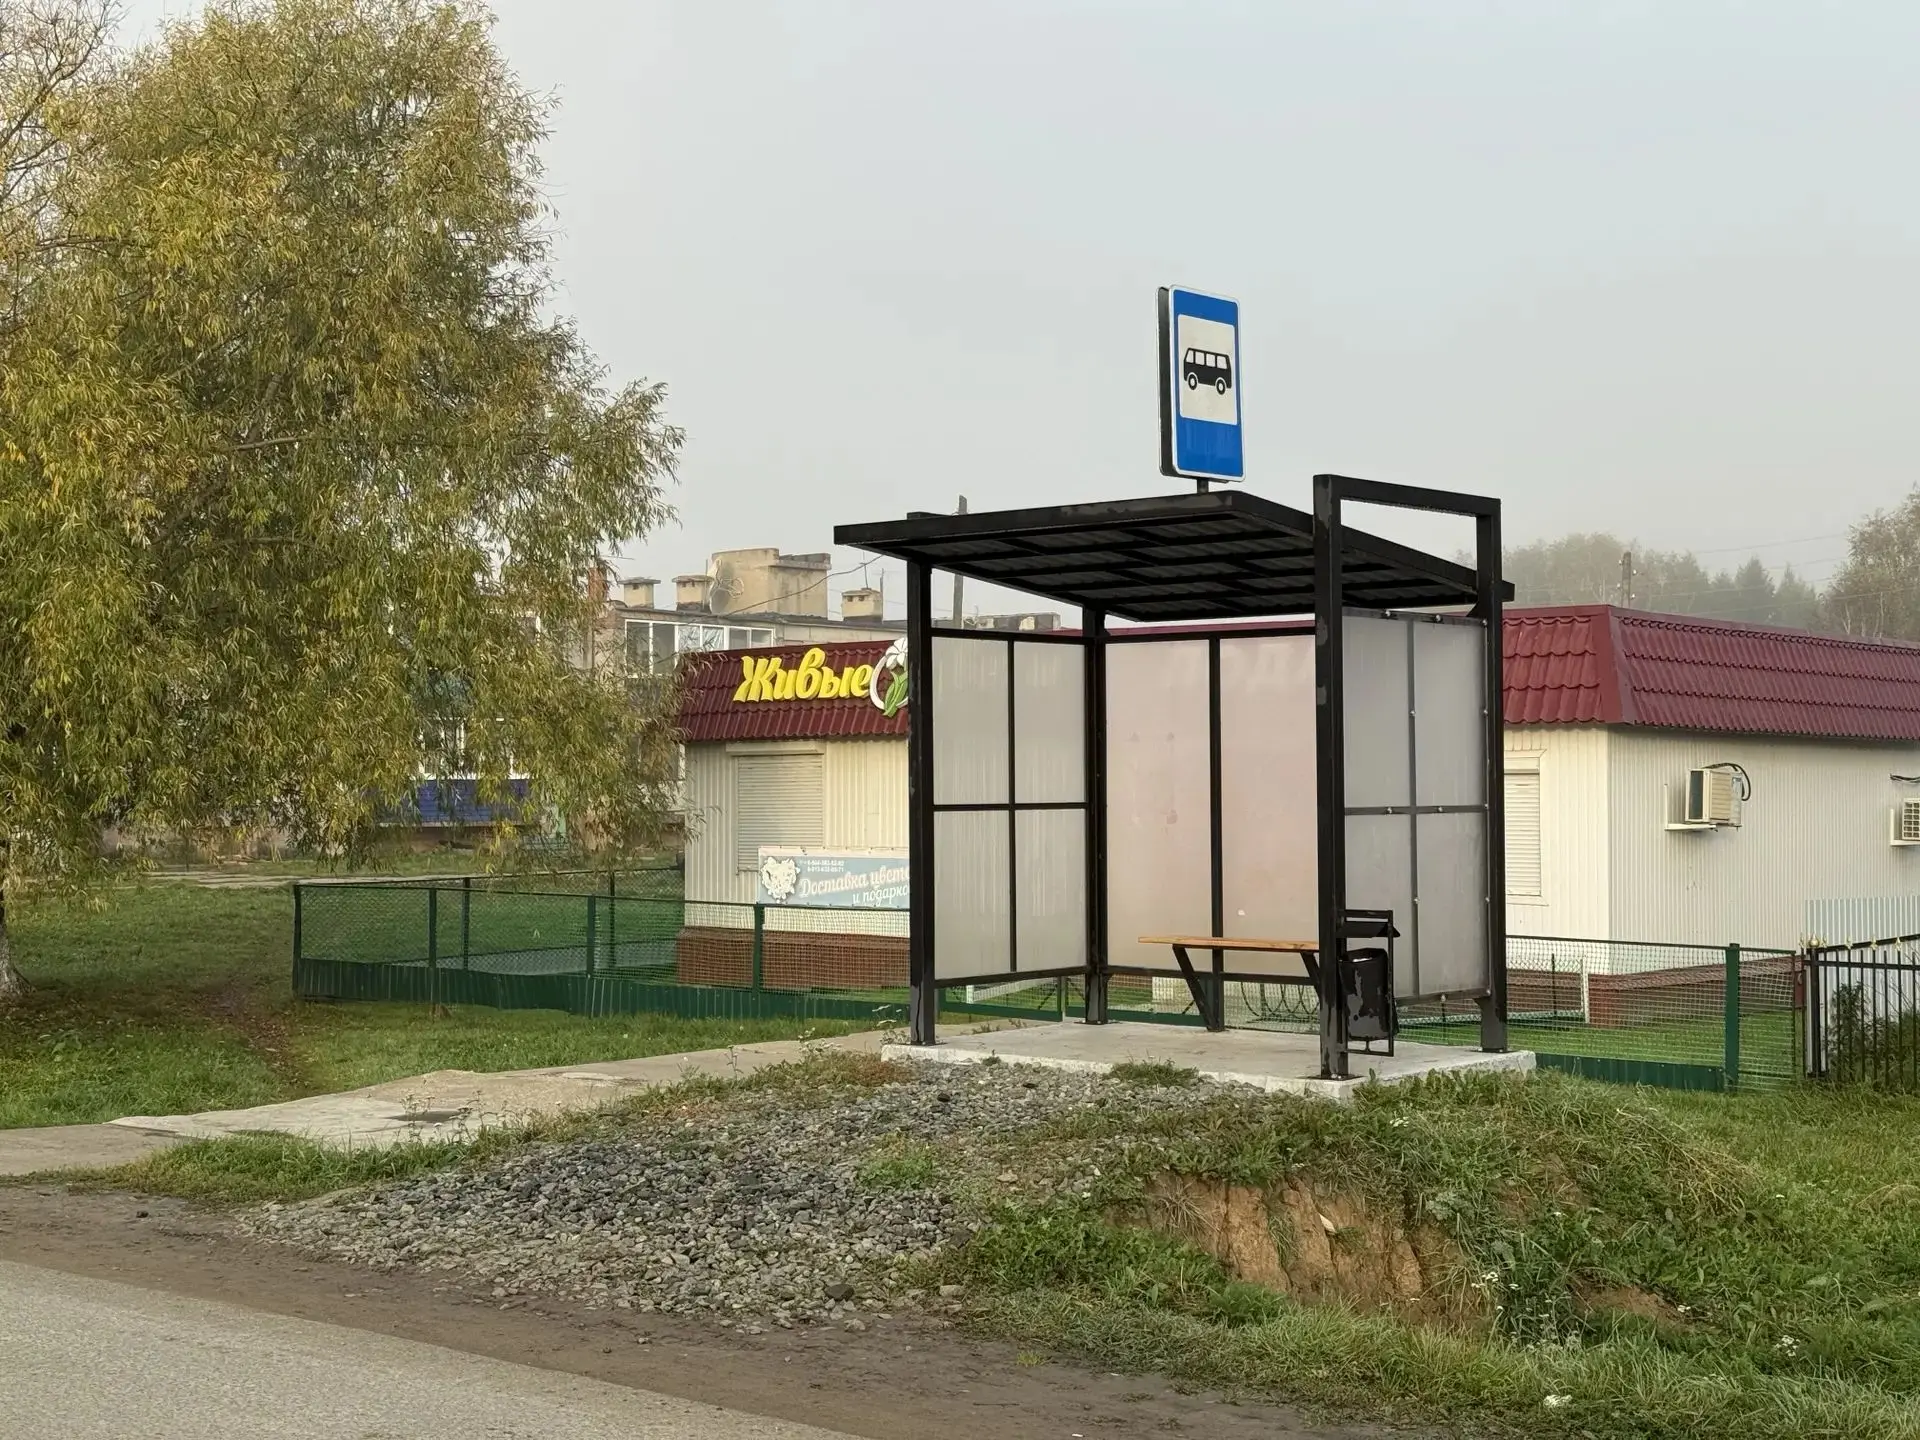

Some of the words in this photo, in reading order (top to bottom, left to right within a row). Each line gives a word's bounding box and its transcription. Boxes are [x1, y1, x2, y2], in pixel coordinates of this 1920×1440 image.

[732, 647, 873, 701] Живые
[799, 872, 868, 897] Доставка
[870, 865, 909, 886] цвето
[853, 893, 860, 904] и
[863, 884, 909, 906] подарко
